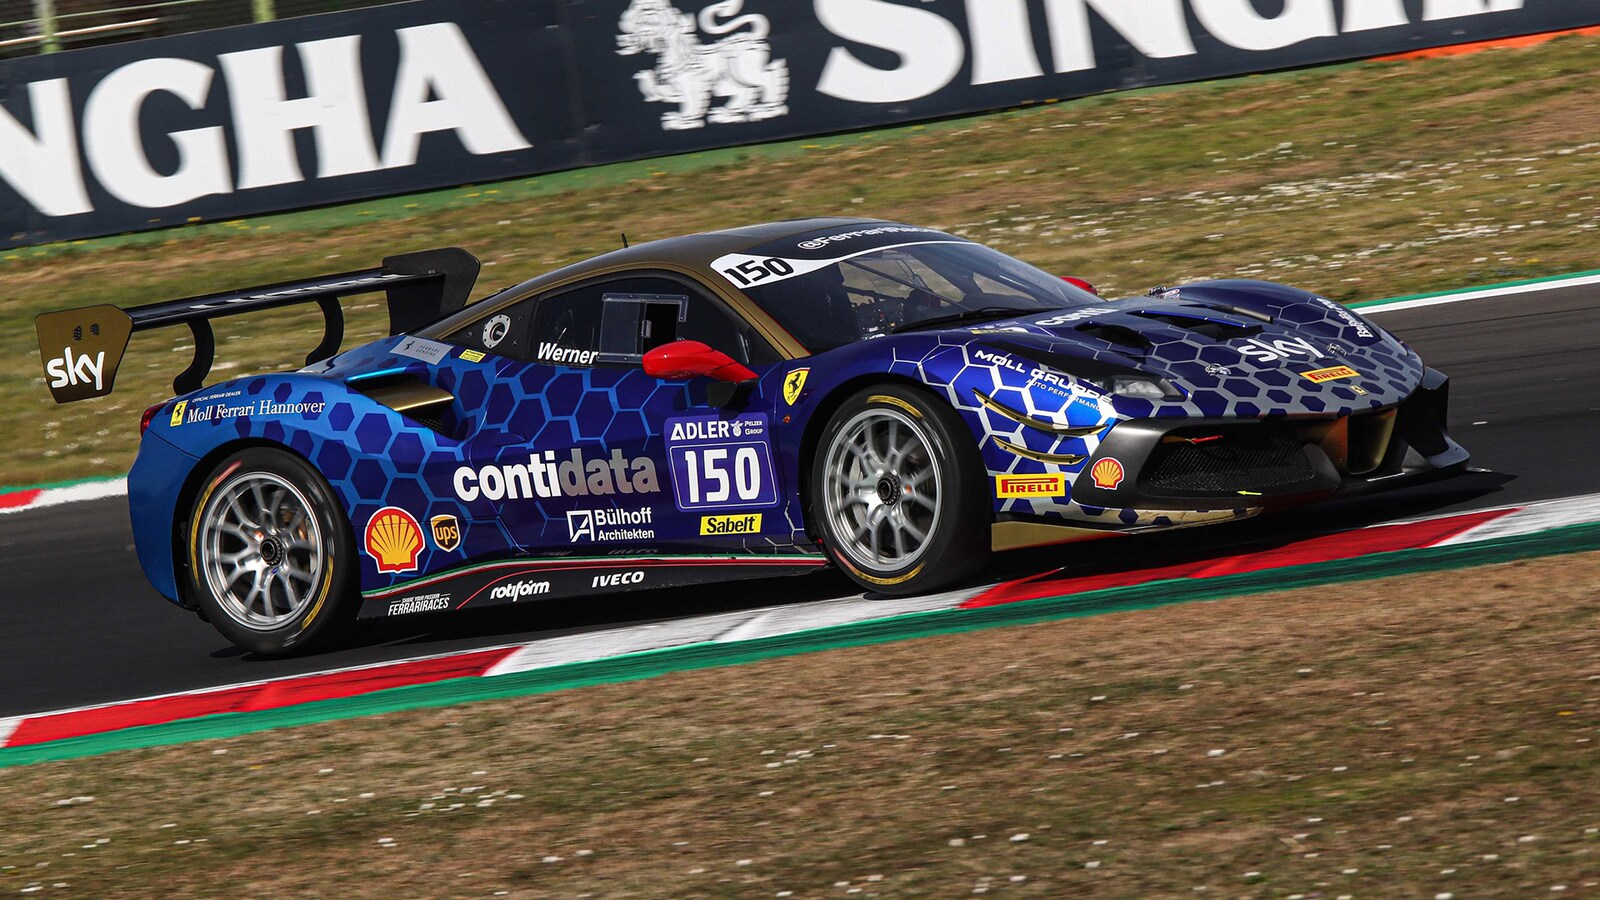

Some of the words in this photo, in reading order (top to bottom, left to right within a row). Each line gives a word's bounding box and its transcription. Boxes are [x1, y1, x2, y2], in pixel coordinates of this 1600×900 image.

[723, 257, 794, 286] 150
[537, 341, 600, 365] Werner
[1236, 337, 1325, 362] sky
[45, 346, 106, 391] sky
[974, 350, 1026, 374] MOLL
[1307, 368, 1353, 380] PIRELLI
[186, 405, 213, 424] Moll
[214, 401, 255, 420] Ferrari
[258, 399, 326, 416] Hannover
[670, 420, 730, 441] ADLER
[453, 448, 661, 502] contidata
[684, 447, 761, 504] 150
[1001, 477, 1059, 494] PIRELLI
[595, 506, 653, 528] Bülhoff
[706, 516, 755, 534] Sabelt
[435, 524, 458, 545] ups
[597, 528, 655, 542] Architekten
[592, 571, 645, 588] IVECO
[490, 580, 551, 602] rotiform
[387, 597, 450, 617] FERRARIRACES
